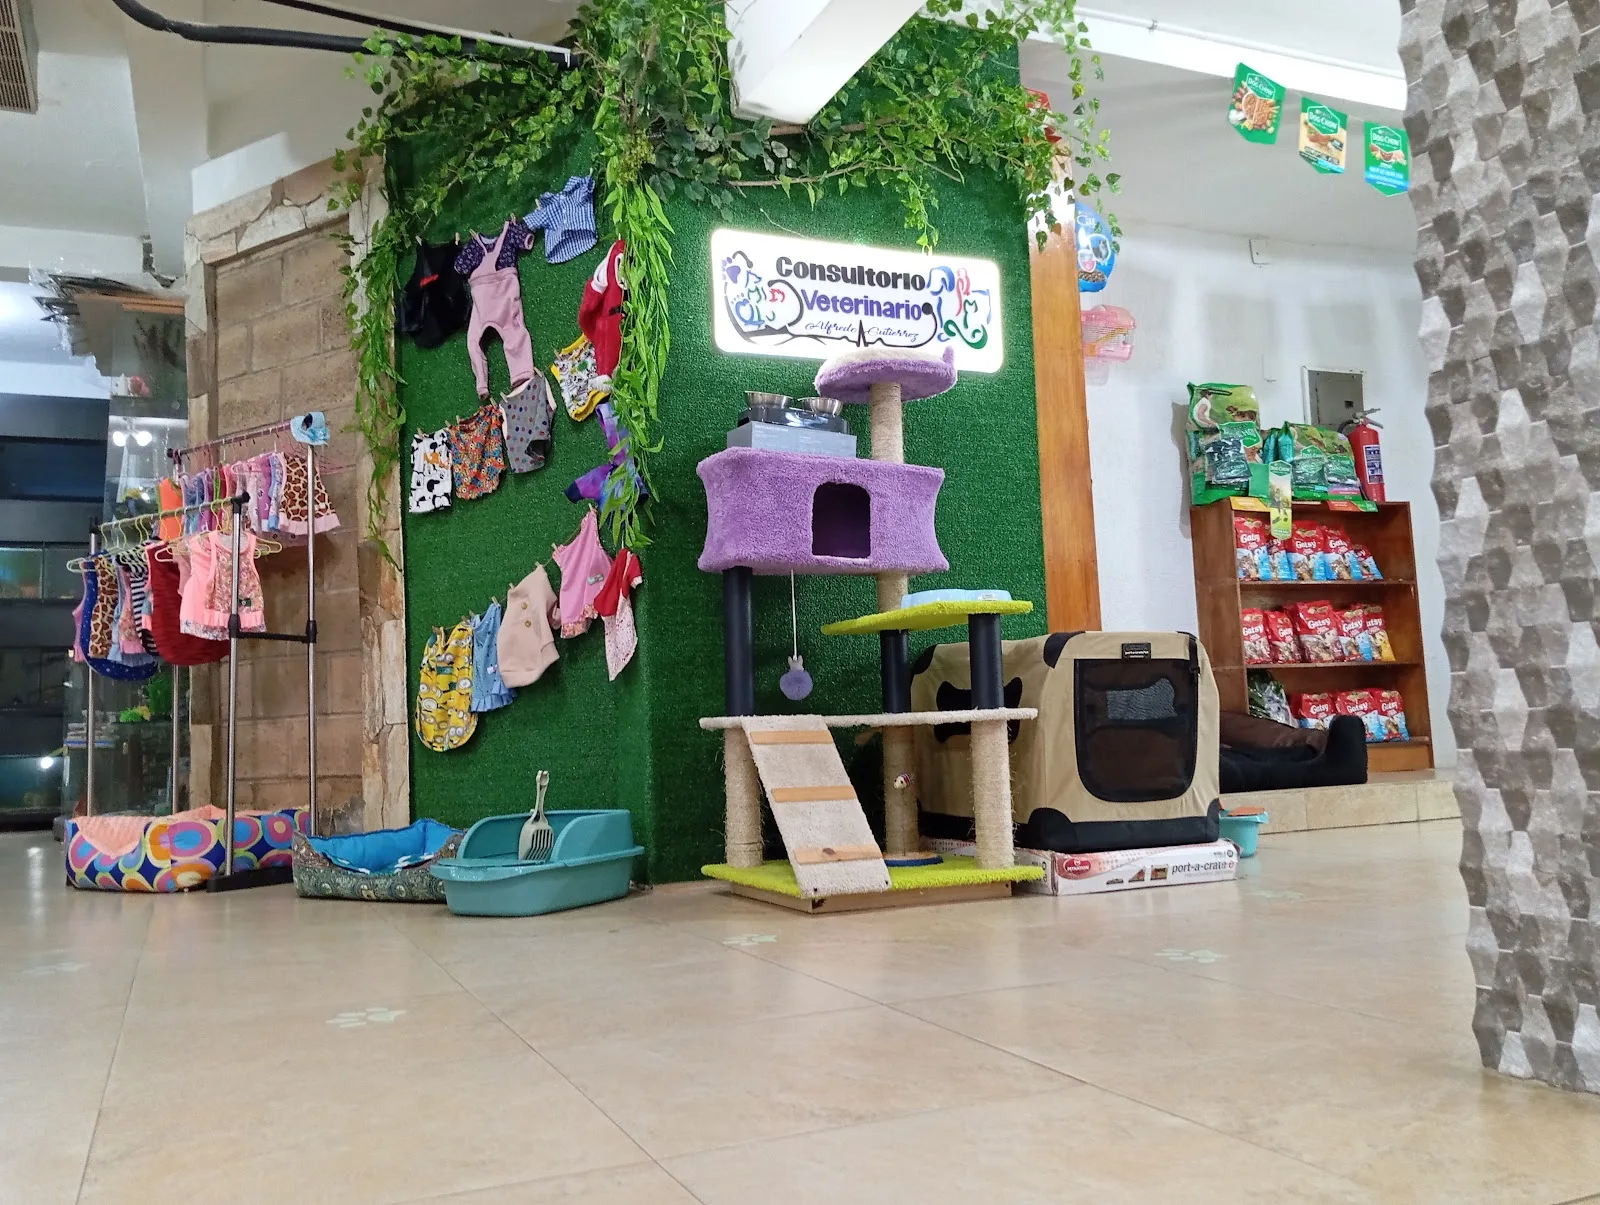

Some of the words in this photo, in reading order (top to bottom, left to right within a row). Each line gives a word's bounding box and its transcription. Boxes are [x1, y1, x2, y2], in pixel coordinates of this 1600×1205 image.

[776, 256, 926, 291] Consultorio
[801, 289, 922, 321] Veterinario
[805, 321, 857, 335] Alfredo
[1307, 617, 1331, 629] Gatsy
[1342, 620, 1363, 633] Gatsy
[1310, 703, 1329, 714] Gatsy
[1346, 702, 1368, 713] Gatsy
[1381, 701, 1398, 711] Gatsy
[1172, 861, 1227, 876] port-a-crate
